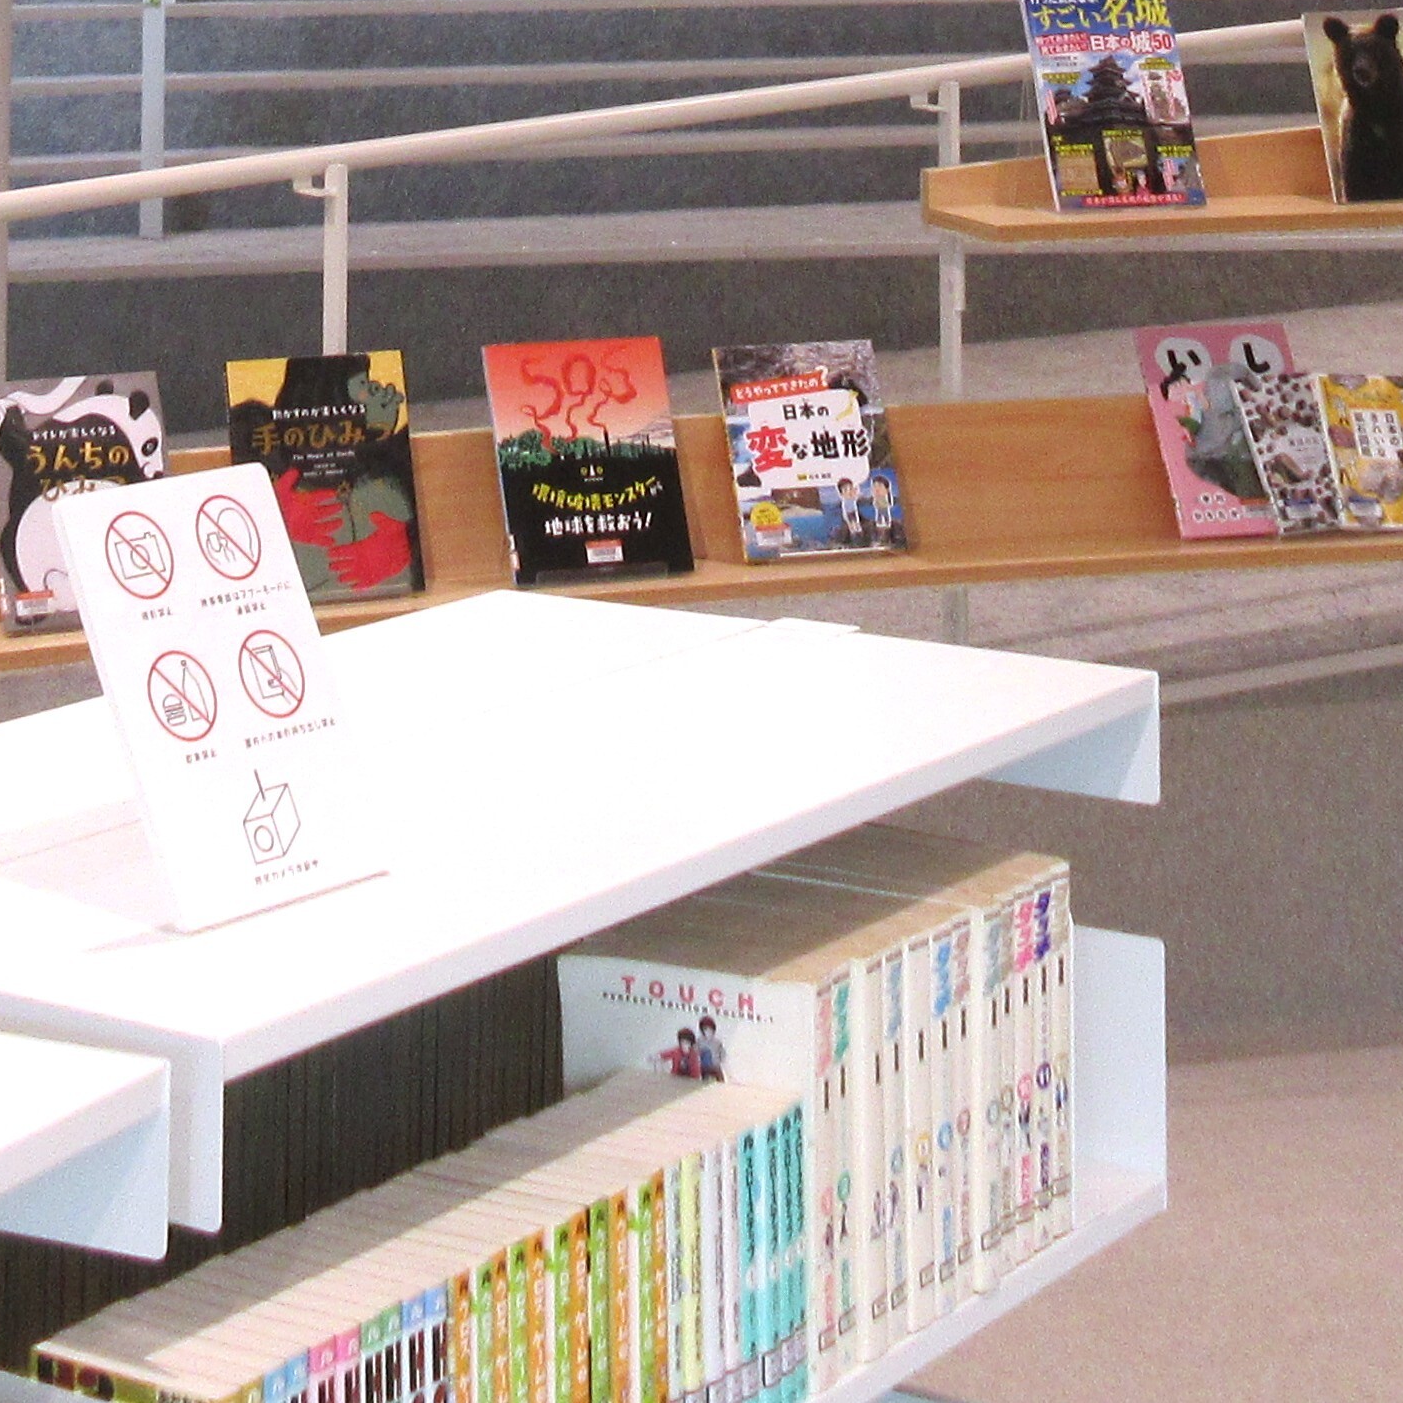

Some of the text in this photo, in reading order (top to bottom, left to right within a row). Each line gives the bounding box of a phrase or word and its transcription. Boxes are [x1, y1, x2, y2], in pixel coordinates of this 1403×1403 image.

[782, 401, 829, 420] 日本の
[252, 419, 391, 456] 手のひみつ
[746, 425, 869, 473] 変な地形
[27, 441, 129, 474] うんちの
[620, 975, 755, 1014] TOUCH
